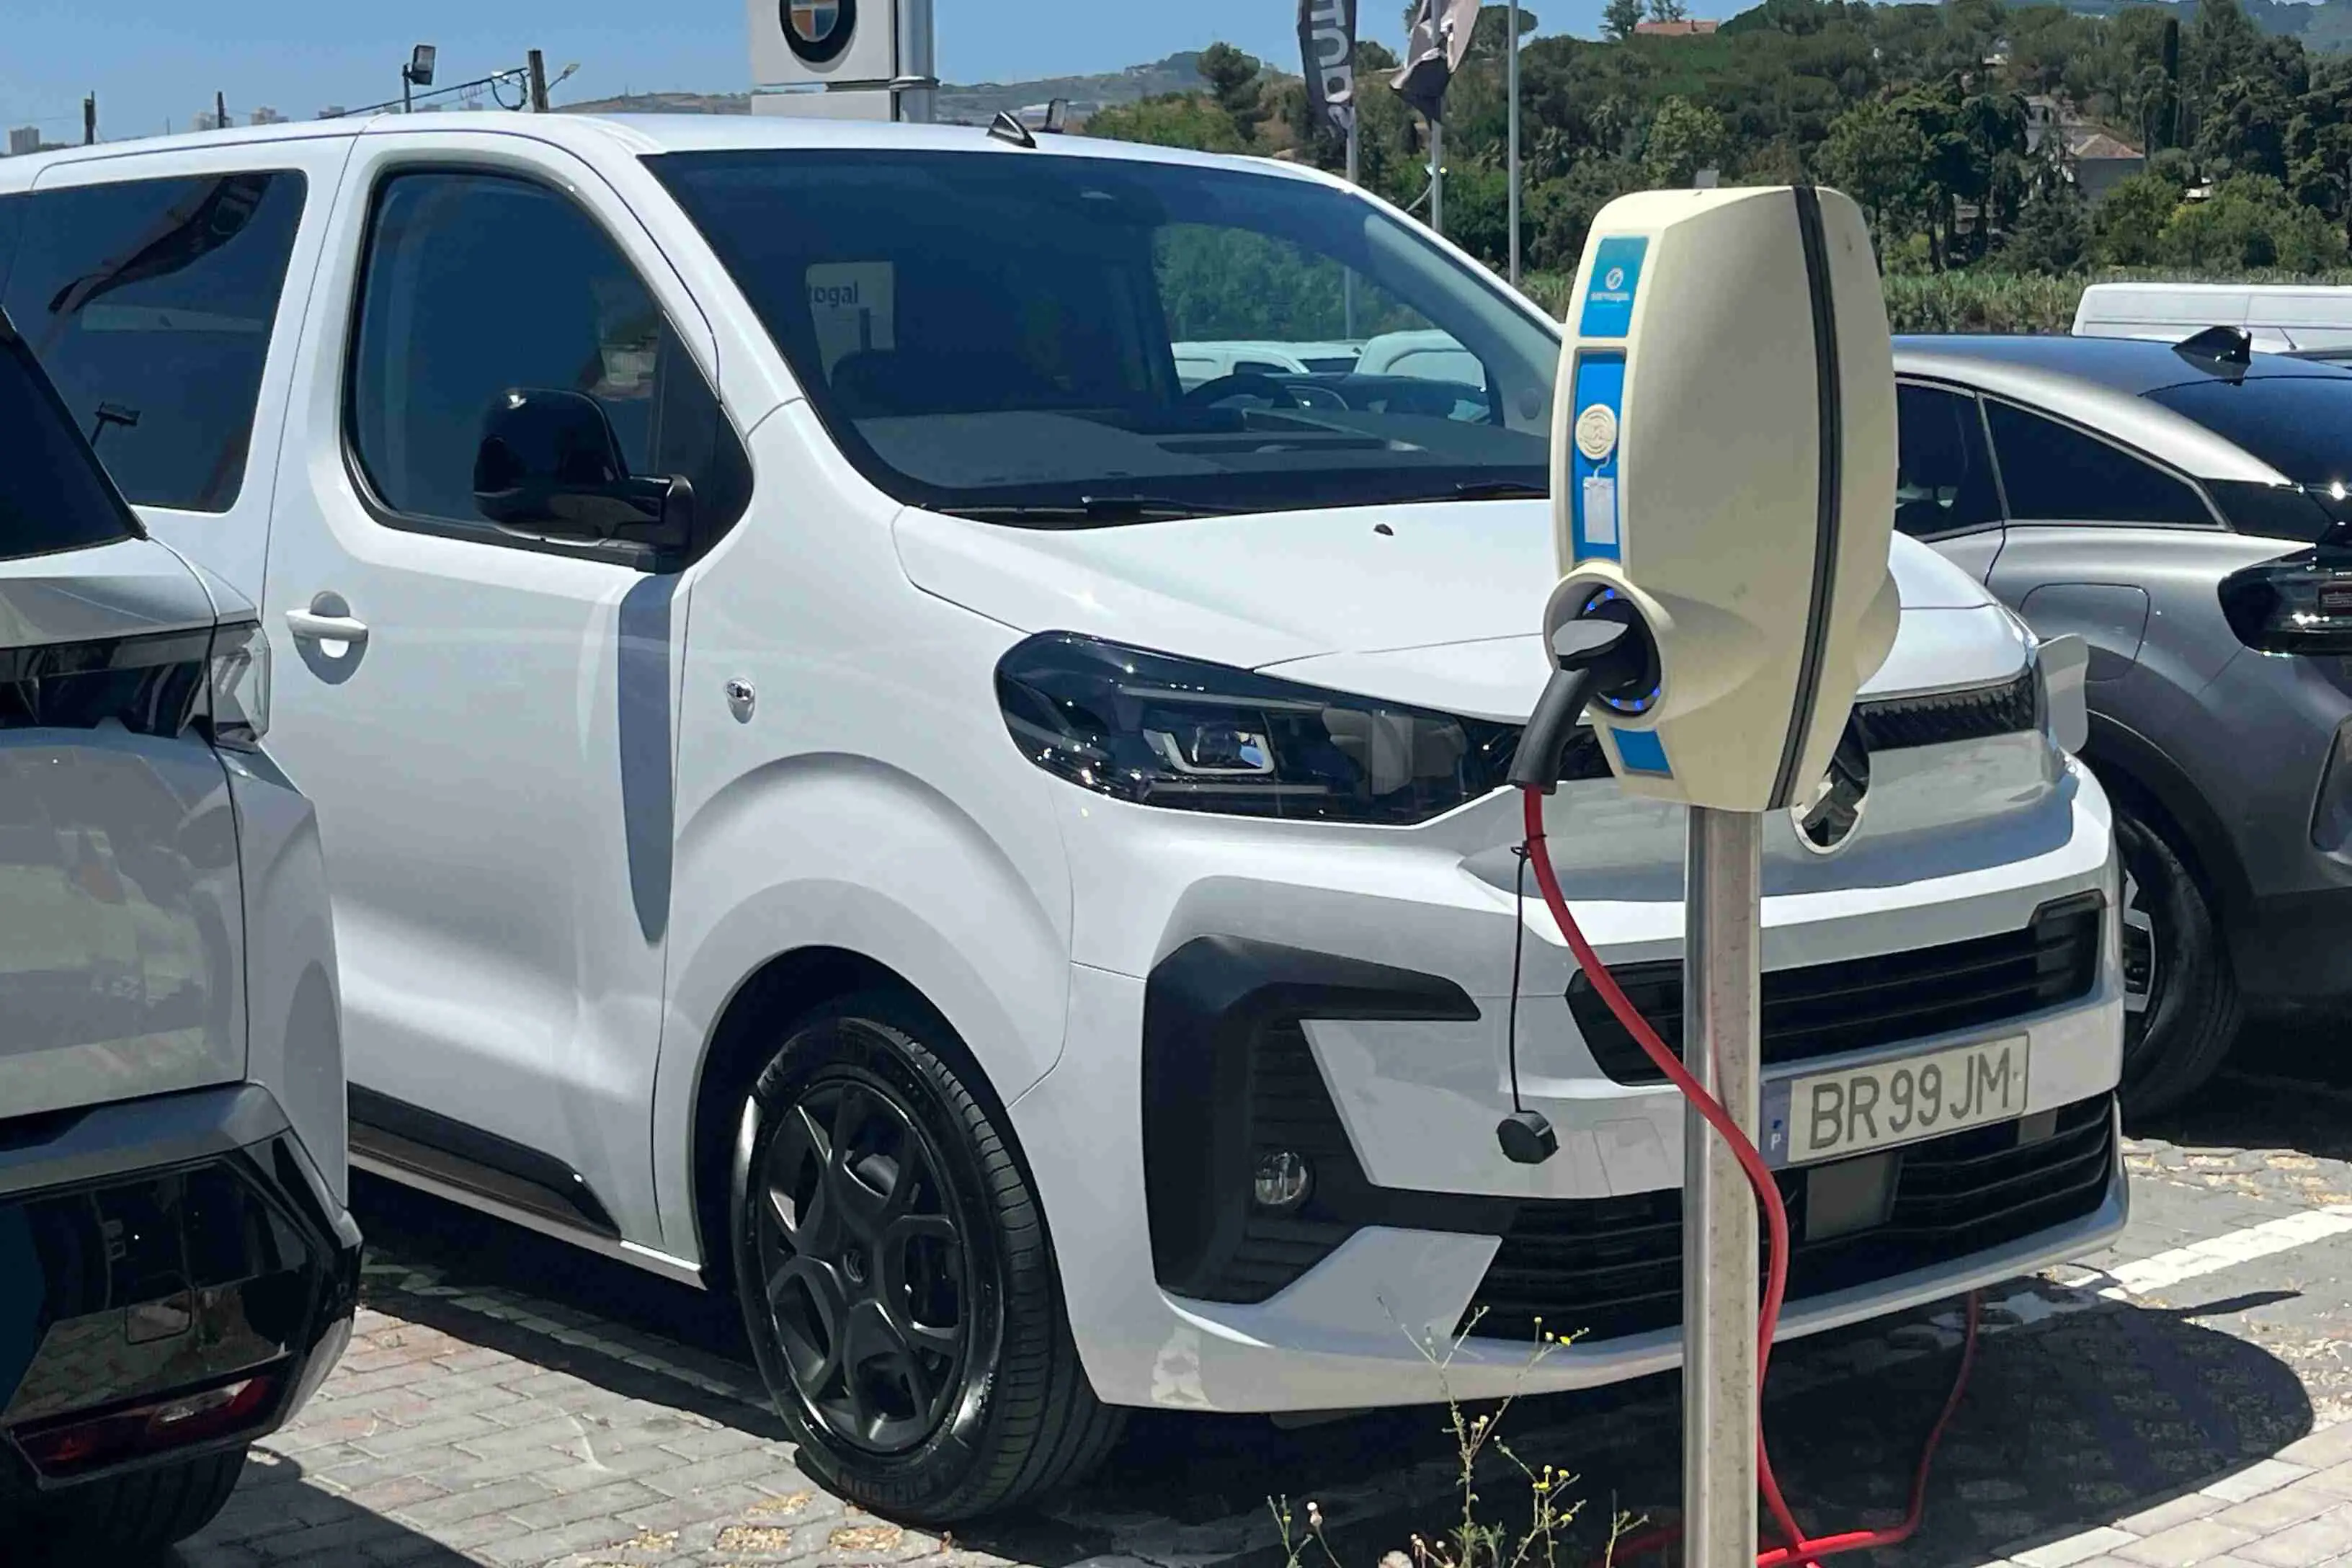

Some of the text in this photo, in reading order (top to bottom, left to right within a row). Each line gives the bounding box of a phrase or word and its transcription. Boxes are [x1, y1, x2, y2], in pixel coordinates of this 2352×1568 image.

[1810, 1048, 2010, 1149] BR 99 JM
[1770, 1133, 1781, 1151] P
